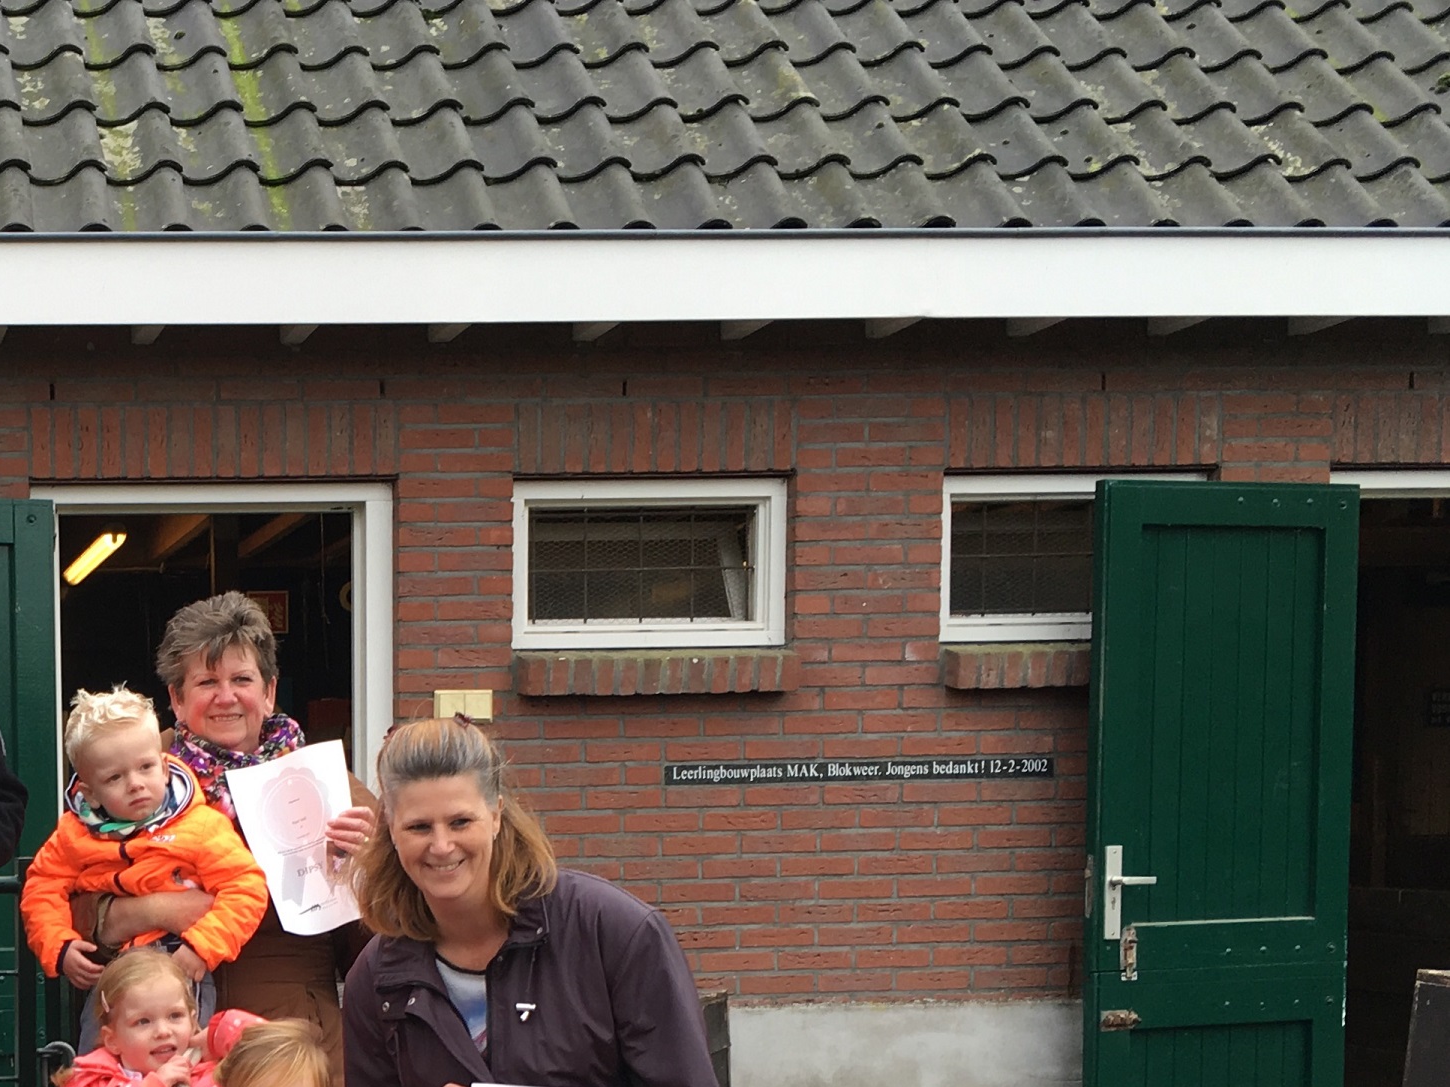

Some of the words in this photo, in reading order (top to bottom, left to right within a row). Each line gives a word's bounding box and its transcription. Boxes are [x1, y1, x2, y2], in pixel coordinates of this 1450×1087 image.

[672, 764, 783, 782] Leerlingbouwplaats
[786, 763, 824, 779] MAK,
[885, 762, 929, 777] Jongens
[990, 759, 1048, 773] 12-2-2002
